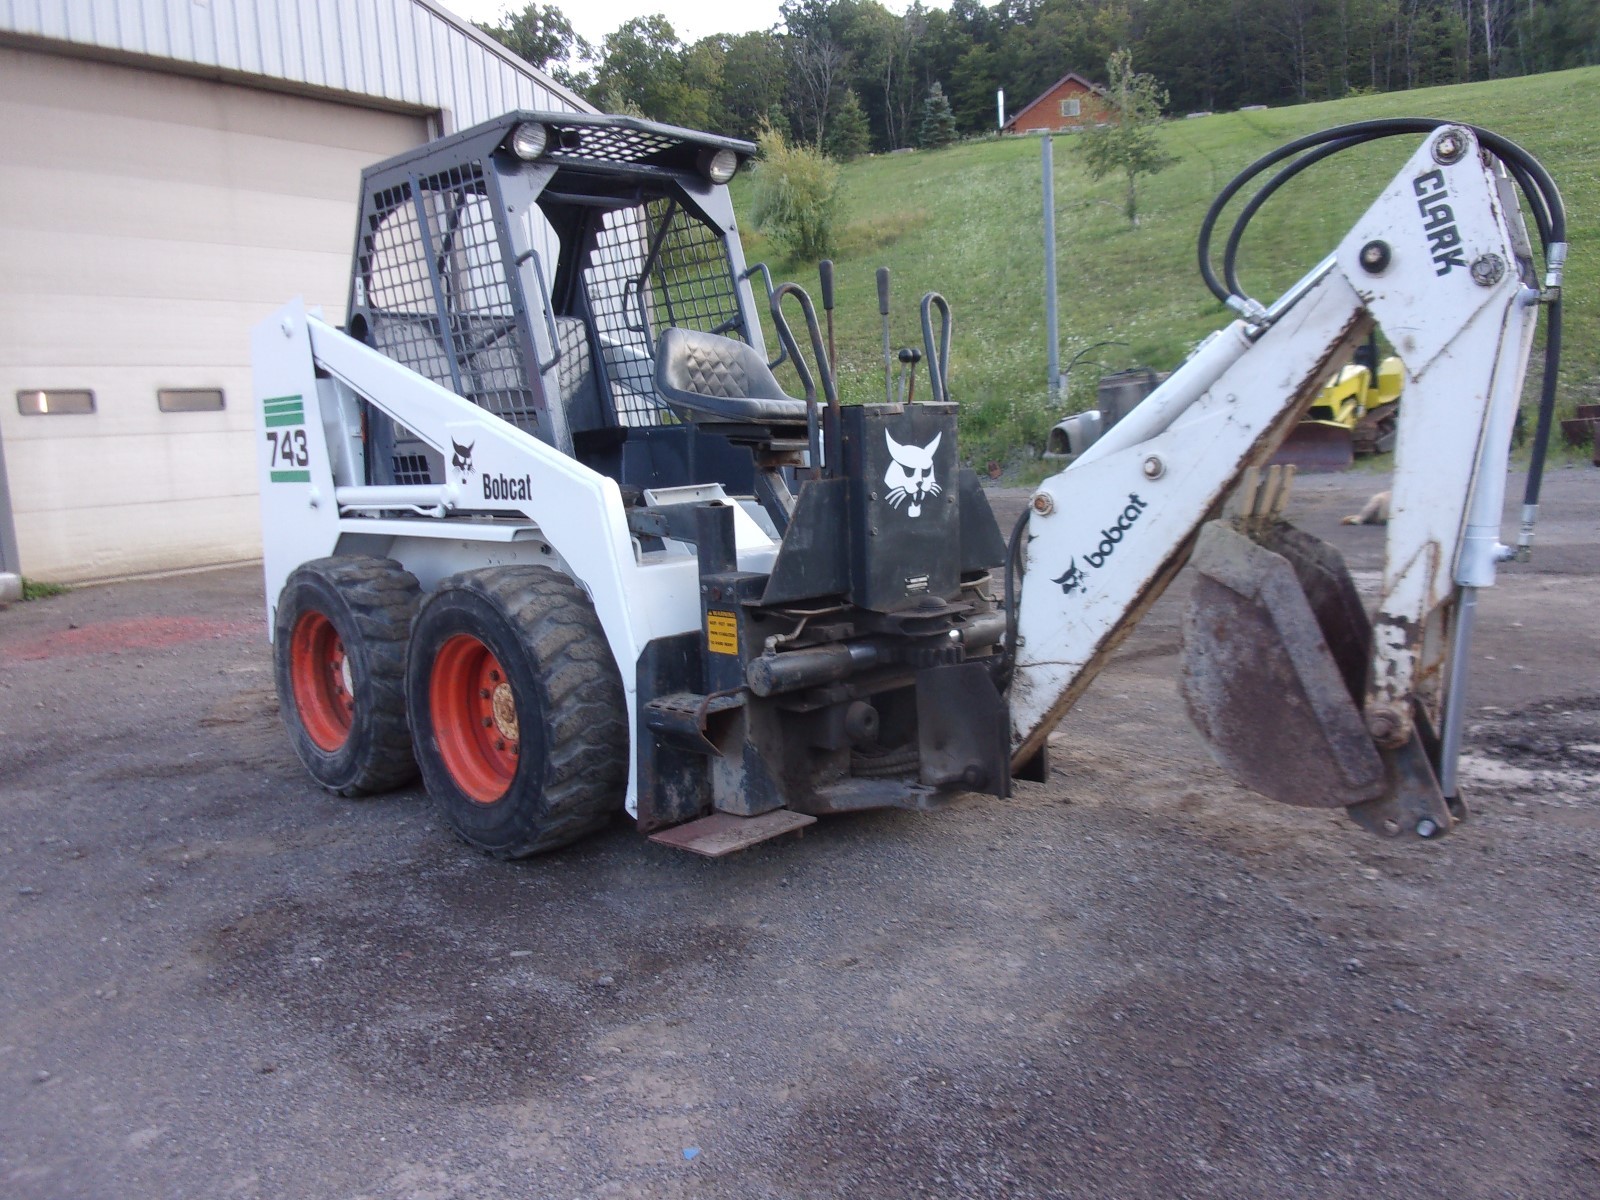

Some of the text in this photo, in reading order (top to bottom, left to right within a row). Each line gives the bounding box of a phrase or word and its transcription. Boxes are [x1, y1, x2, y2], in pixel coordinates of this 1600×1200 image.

[1412, 168, 1467, 277] CLARK
[266, 429, 309, 467] 743
[482, 474, 533, 501] Bobcat
[1083, 492, 1148, 569] bobcat
